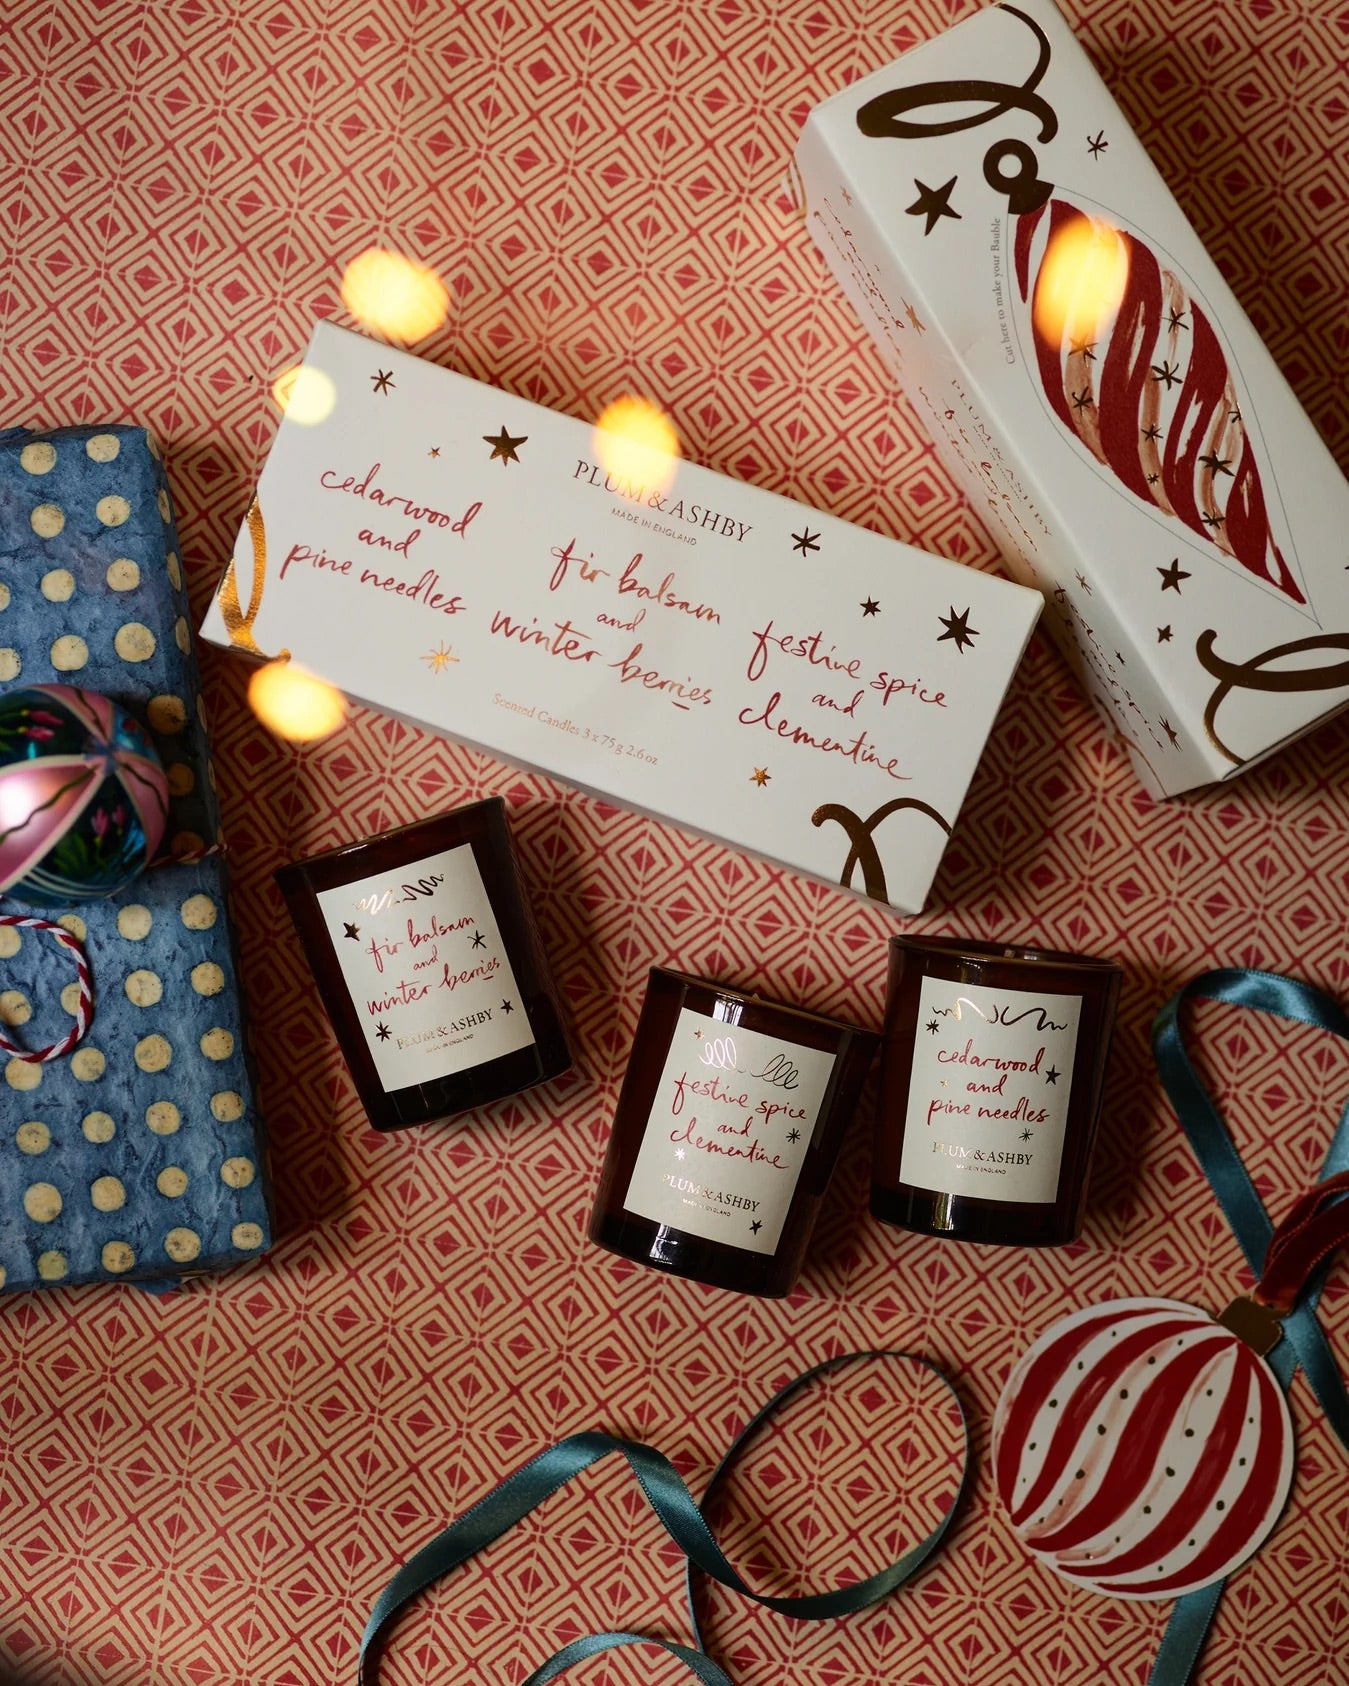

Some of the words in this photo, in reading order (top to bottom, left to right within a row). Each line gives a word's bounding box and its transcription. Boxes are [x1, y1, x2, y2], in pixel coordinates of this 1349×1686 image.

[990, 218, 1001, 251] Bauble
[992, 254, 1003, 277] your
[992, 281, 1003, 306] make
[1000, 323, 1011, 344] here
[1005, 346, 1016, 365] Cut
[321, 463, 482, 539] cedarwood
[357, 529, 421, 558] and
[611, 507, 639, 525] MADE
[641, 519, 652, 529] IN
[653, 522, 697, 546] ENGLAND
[279, 543, 353, 580] pine
[361, 569, 466, 615] needles
[549, 538, 610, 591] fir
[618, 553, 721, 625] balsam
[597, 608, 647, 633] and
[490, 609, 603, 664] winter
[609, 643, 714, 707] berries
[748, 620, 862, 682] festive
[869, 671, 948, 708] spice
[492, 692, 536, 718] Scented
[537, 709, 580, 736] Candles
[582, 727, 590, 739] 3
[592, 732, 599, 742] x
[812, 690, 867, 719] and
[738, 692, 913, 781] clementine
[365, 937, 404, 974] fir
[407, 915, 475, 948] balsam
[413, 945, 438, 971] and
[367, 981, 432, 1016] winter
[438, 957, 501, 991] berries
[937, 1039, 1046, 1075] cedarwood
[672, 1072, 750, 1115] festive
[755, 1100, 808, 1124] spice
[966, 1074, 1008, 1096] and
[717, 1116, 753, 1137] and
[927, 1099, 971, 1126] pine
[978, 1096, 1050, 1123] needles
[670, 1117, 789, 1169] clementine
